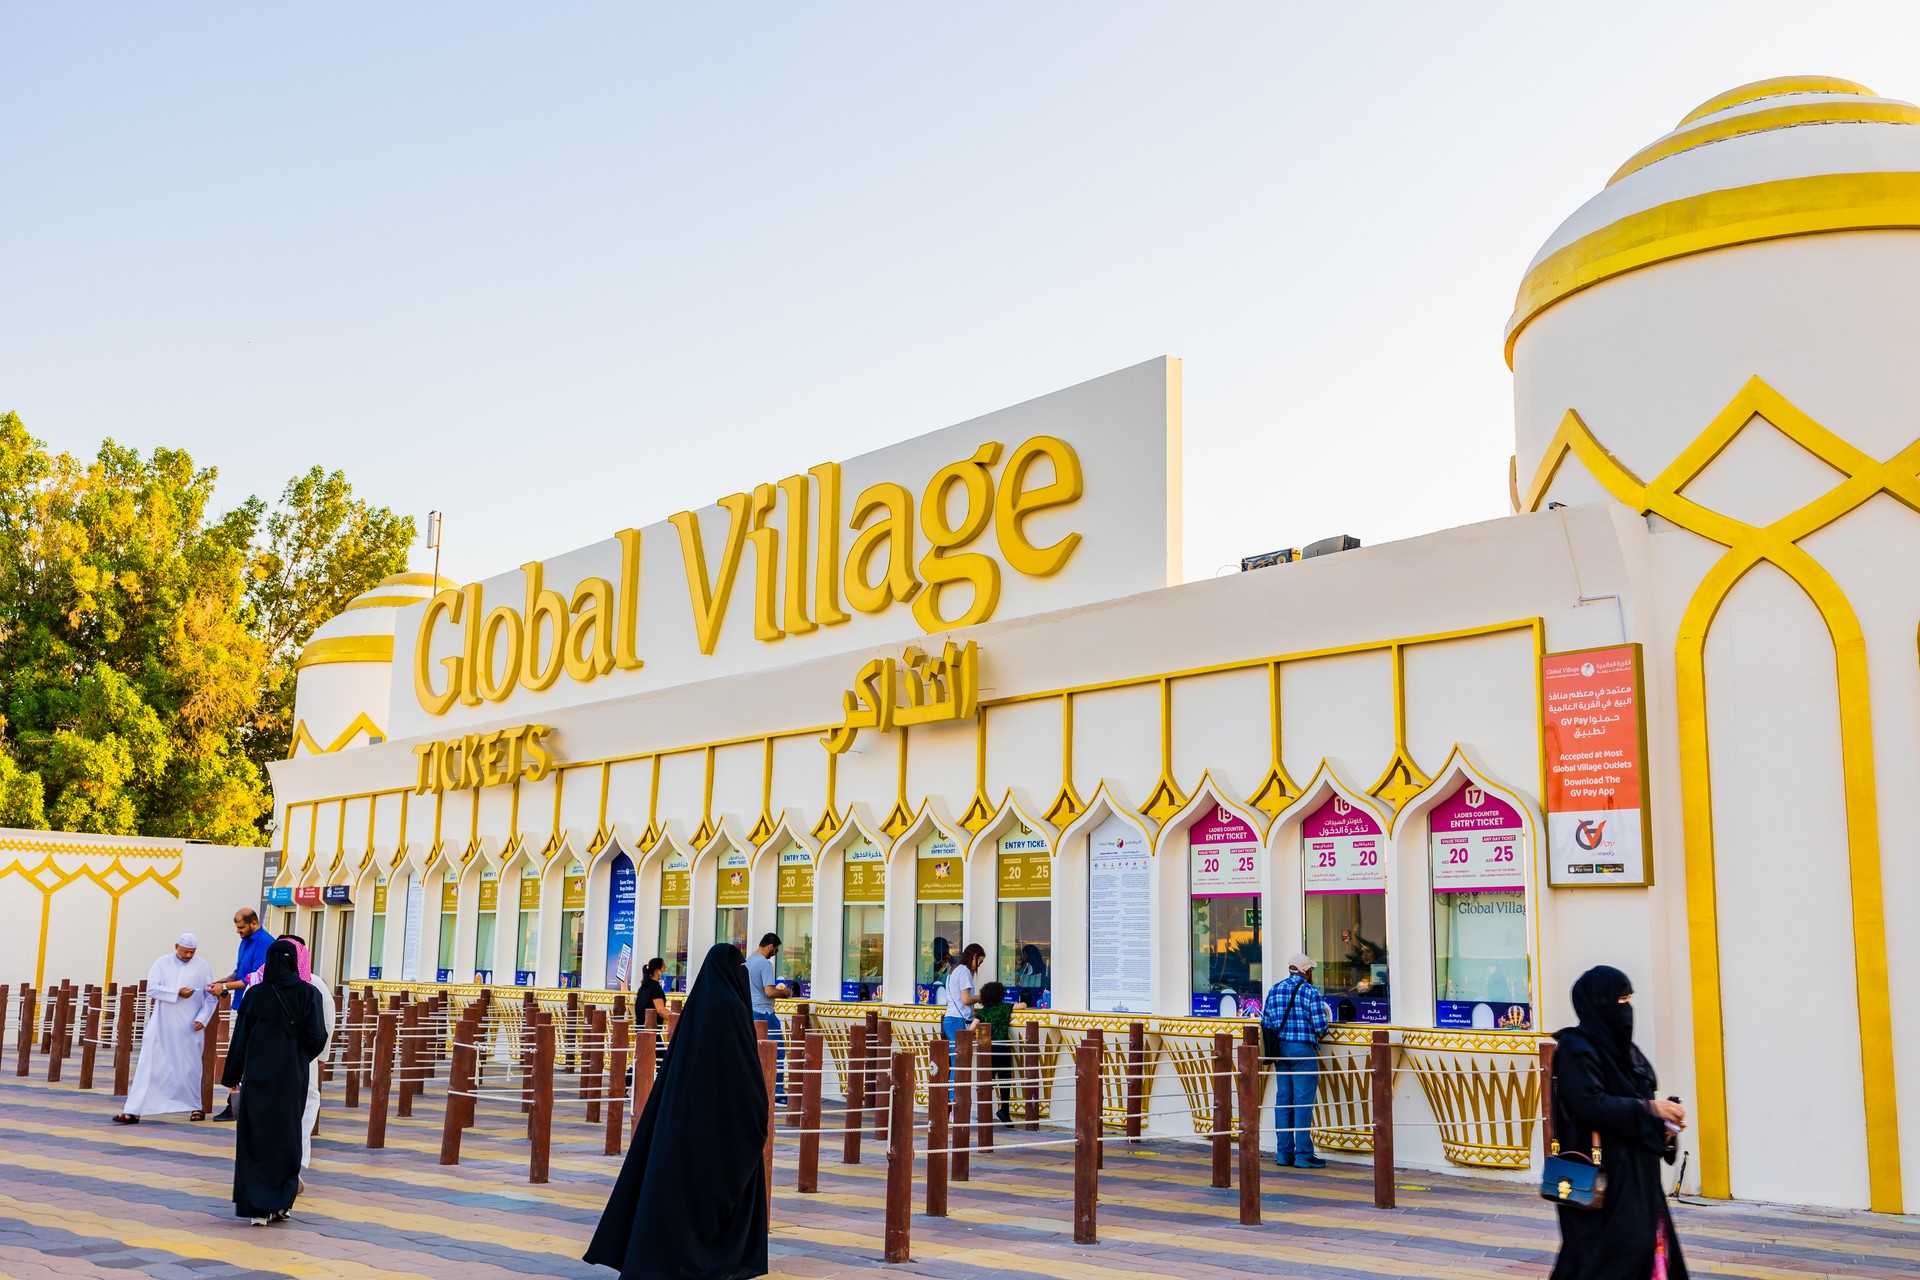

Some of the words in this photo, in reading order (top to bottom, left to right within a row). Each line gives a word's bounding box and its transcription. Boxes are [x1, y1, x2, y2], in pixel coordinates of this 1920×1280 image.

[414, 528, 645, 715] Global
[668, 434, 1084, 655] Village
[820, 639, 980, 754] التذاكر
[1548, 692, 1568, 701] منافذ
[1569, 690, 1594, 700] معظم
[1595, 688, 1605, 699] في
[1606, 686, 1632, 695] معتمد
[1548, 702, 1578, 714] العالمية
[1579, 700, 1600, 711] القرية
[1601, 699, 1612, 711] في
[1614, 698, 1632, 708] البيع
[1561, 718, 1572, 726] GV
[1573, 718, 1588, 726] Pay
[1573, 726, 1606, 739] تطبيق
[412, 723, 554, 796] TICKETS
[1560, 753, 1594, 762] Accepted
[1603, 749, 1624, 757] Most
[1552, 765, 1576, 773] Global
[1576, 764, 1602, 773] Village
[1603, 761, 1633, 770] Outlets
[1564, 777, 1604, 787] Download
[1467, 789, 1482, 804] 17
[1570, 789, 1582, 797] GV
[1582, 788, 1597, 798] Pay
[1598, 788, 1615, 797] App
[1473, 810, 1500, 818] COUNTER
[1324, 818, 1346, 826] السيدات
[1450, 819, 1475, 828] ENTRY
[1476, 817, 1504, 827] TICKET
[1319, 827, 1344, 837] الدخول
[1344, 824, 1369, 835] تذكرة
[1205, 833, 1225, 841] ENTRY
[1226, 832, 1247, 840] TICKET
[1027, 840, 1047, 848] TICKE
[869, 851, 882, 859] ذكرة
[1319, 852, 1336, 867] 25
[1359, 850, 1378, 866] 20
[1449, 847, 1469, 864] 20
[1493, 845, 1514, 862] 25
[1204, 858, 1219, 873] 20
[1238, 857, 1254, 872] 25
[1008, 866, 1021, 880] 20
[1036, 865, 1049, 879] 25
[786, 876, 796, 888] 20
[852, 872, 863, 885] 25
[668, 881, 676, 892] 25
[1458, 902, 1494, 914] Global
